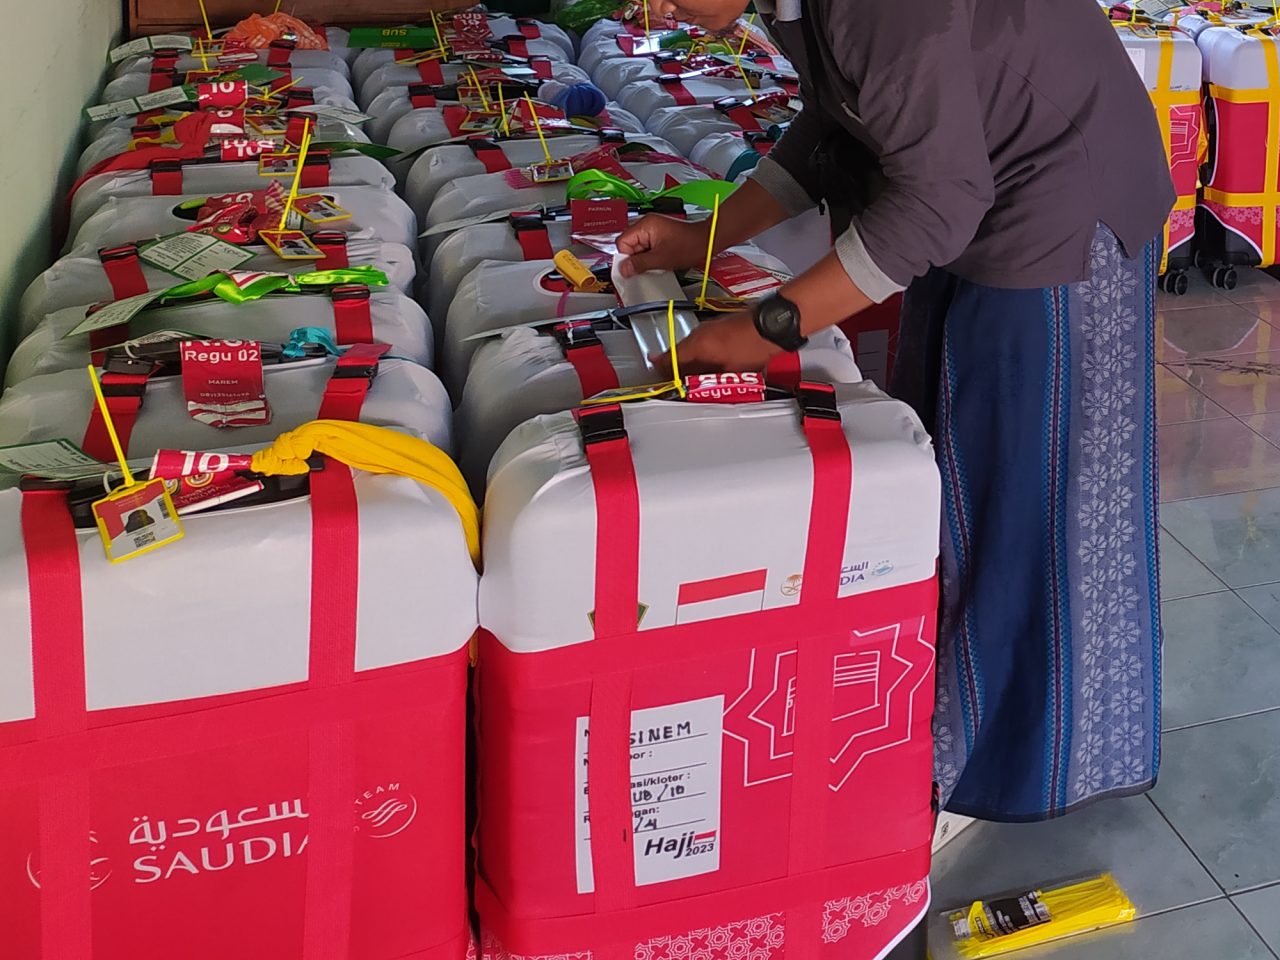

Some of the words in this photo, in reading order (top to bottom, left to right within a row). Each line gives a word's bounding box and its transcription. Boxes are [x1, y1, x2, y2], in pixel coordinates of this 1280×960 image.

[184, 349, 232, 364] Regu
[238, 349, 259, 361] 02
[180, 451, 229, 476] 10
[840, 573, 865, 586] DIA
[129, 798, 309, 852] سعودية
[644, 831, 695, 859] Haji
[685, 843, 715, 857] 2023
